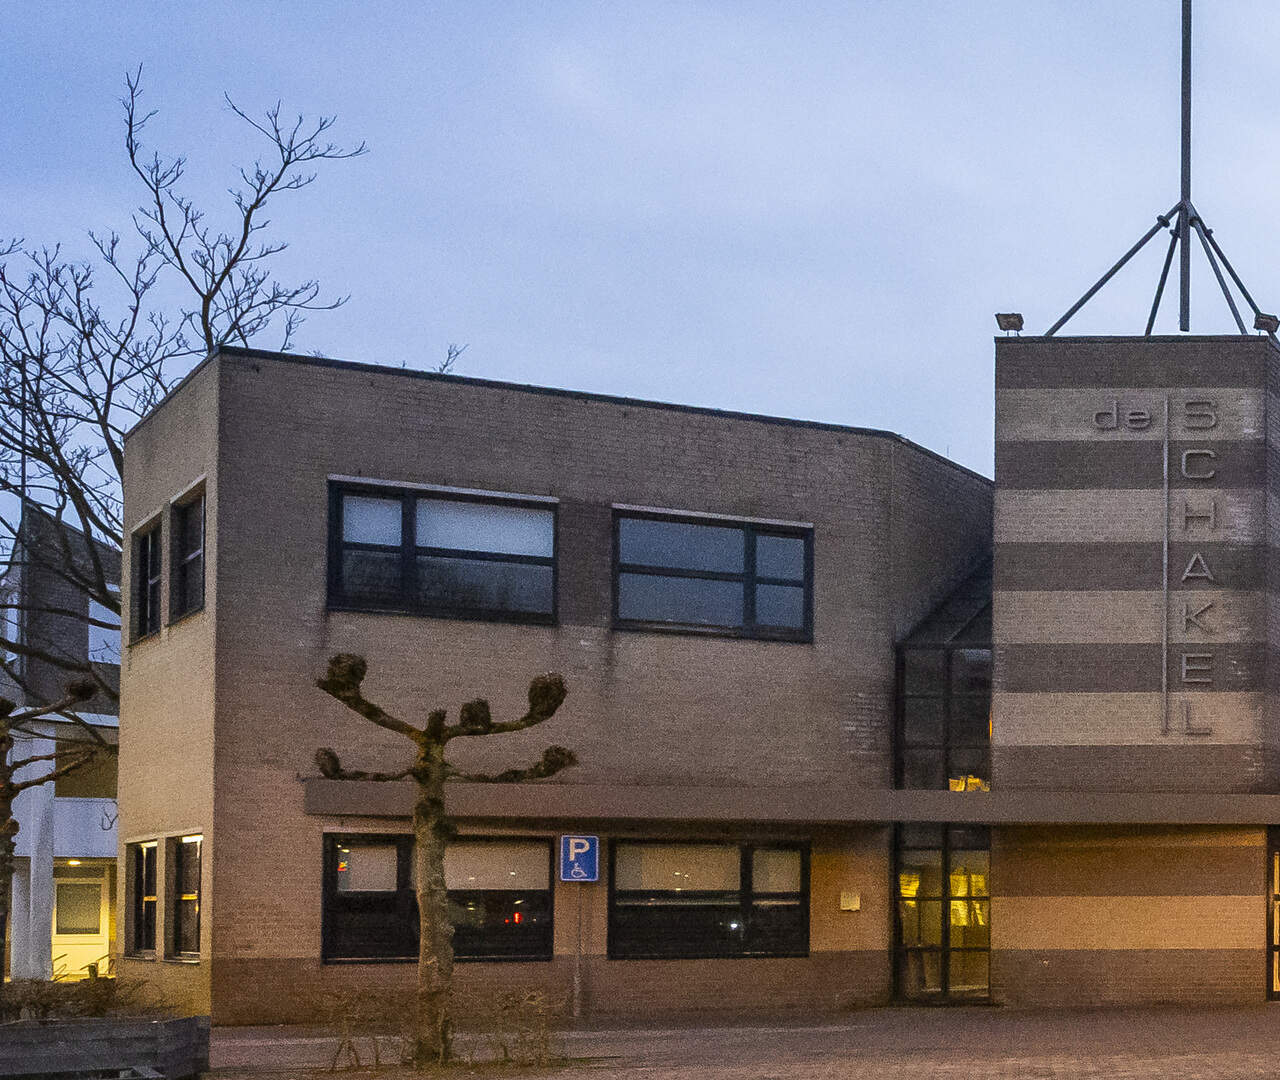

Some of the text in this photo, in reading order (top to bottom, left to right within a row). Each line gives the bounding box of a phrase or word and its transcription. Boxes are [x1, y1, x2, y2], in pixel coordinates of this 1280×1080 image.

[1095, 400, 1217, 736] de SCHAKEL
[569, 838, 590, 861] P
